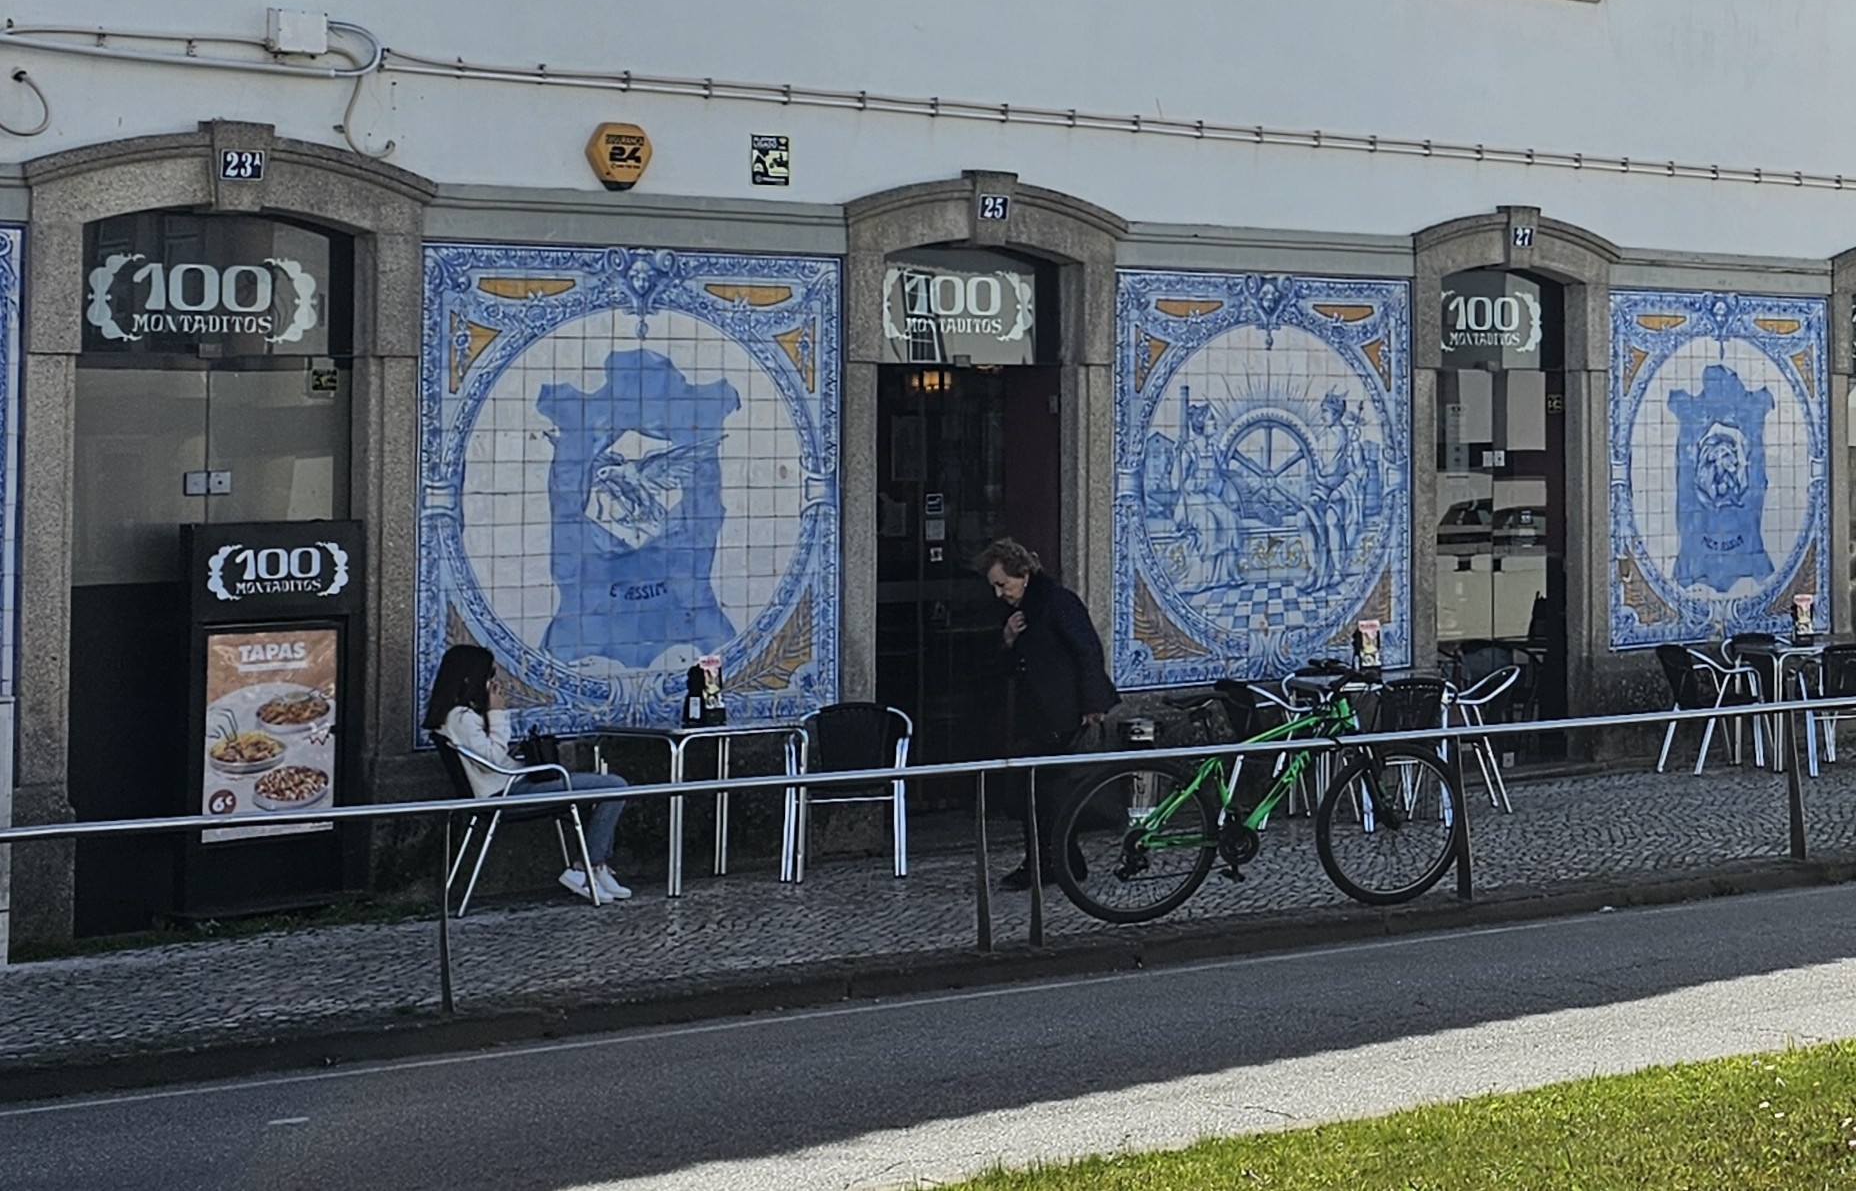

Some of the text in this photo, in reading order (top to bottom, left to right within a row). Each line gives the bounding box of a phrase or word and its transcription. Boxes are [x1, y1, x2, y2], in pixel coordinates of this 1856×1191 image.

[609, 146, 642, 163] 24
[983, 197, 1004, 219] 25
[1515, 228, 1532, 246] 27
[133, 262, 273, 312] 100
[906, 275, 1001, 316] 100
[132, 313, 273, 334] MONTADITOS
[1448, 296, 1519, 331] 100
[1449, 332, 1521, 346] MONTADITOS
[234, 547, 321, 580] 100
[235, 579, 322, 594] MONTADITOS
[238, 641, 308, 663] TAPAS
